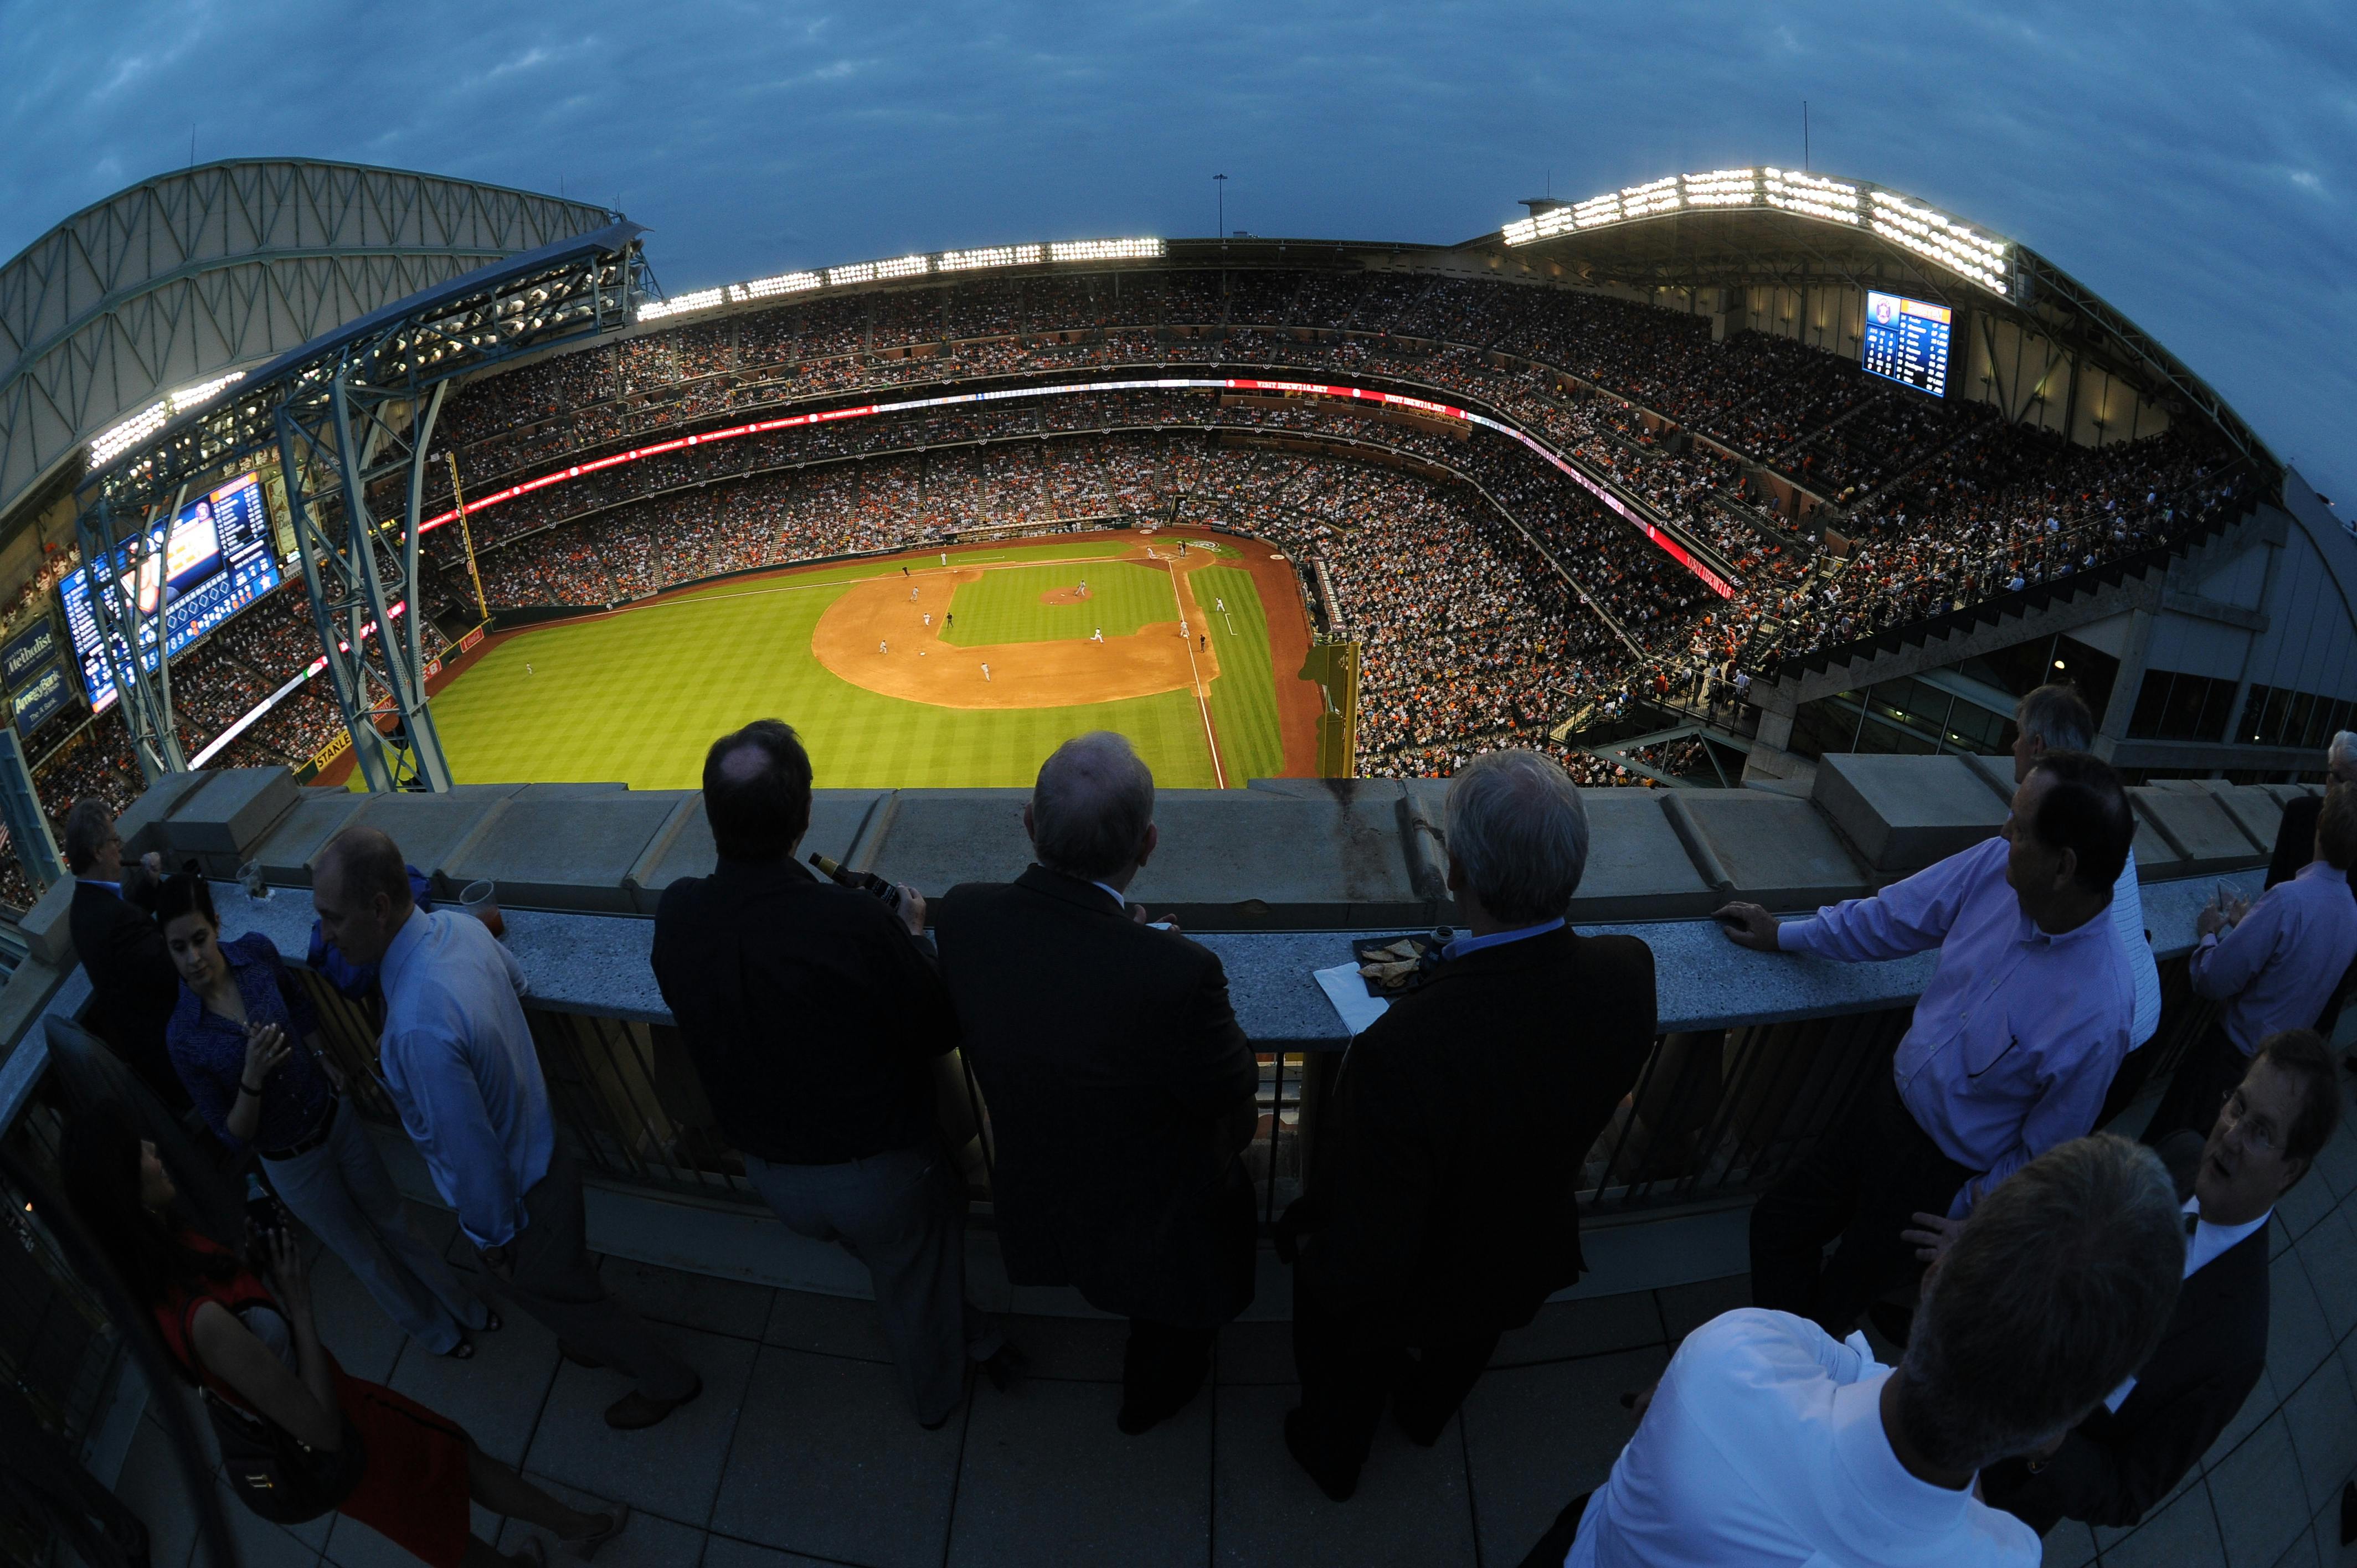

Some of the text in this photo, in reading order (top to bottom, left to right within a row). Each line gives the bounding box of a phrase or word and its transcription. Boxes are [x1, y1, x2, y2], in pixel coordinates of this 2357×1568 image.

[1385, 394, 1403, 404] VISIT
[1687, 554, 1703, 577] VISIT
[7, 632, 52, 675] Methodist
[170, 635, 212, 667] DAKTRONICS
[171, 638, 177, 649] 8
[177, 632, 184, 644] 9
[15, 670, 60, 714] AmegyBank
[29, 711, 39, 721] The
[317, 733, 351, 767] STANLE
